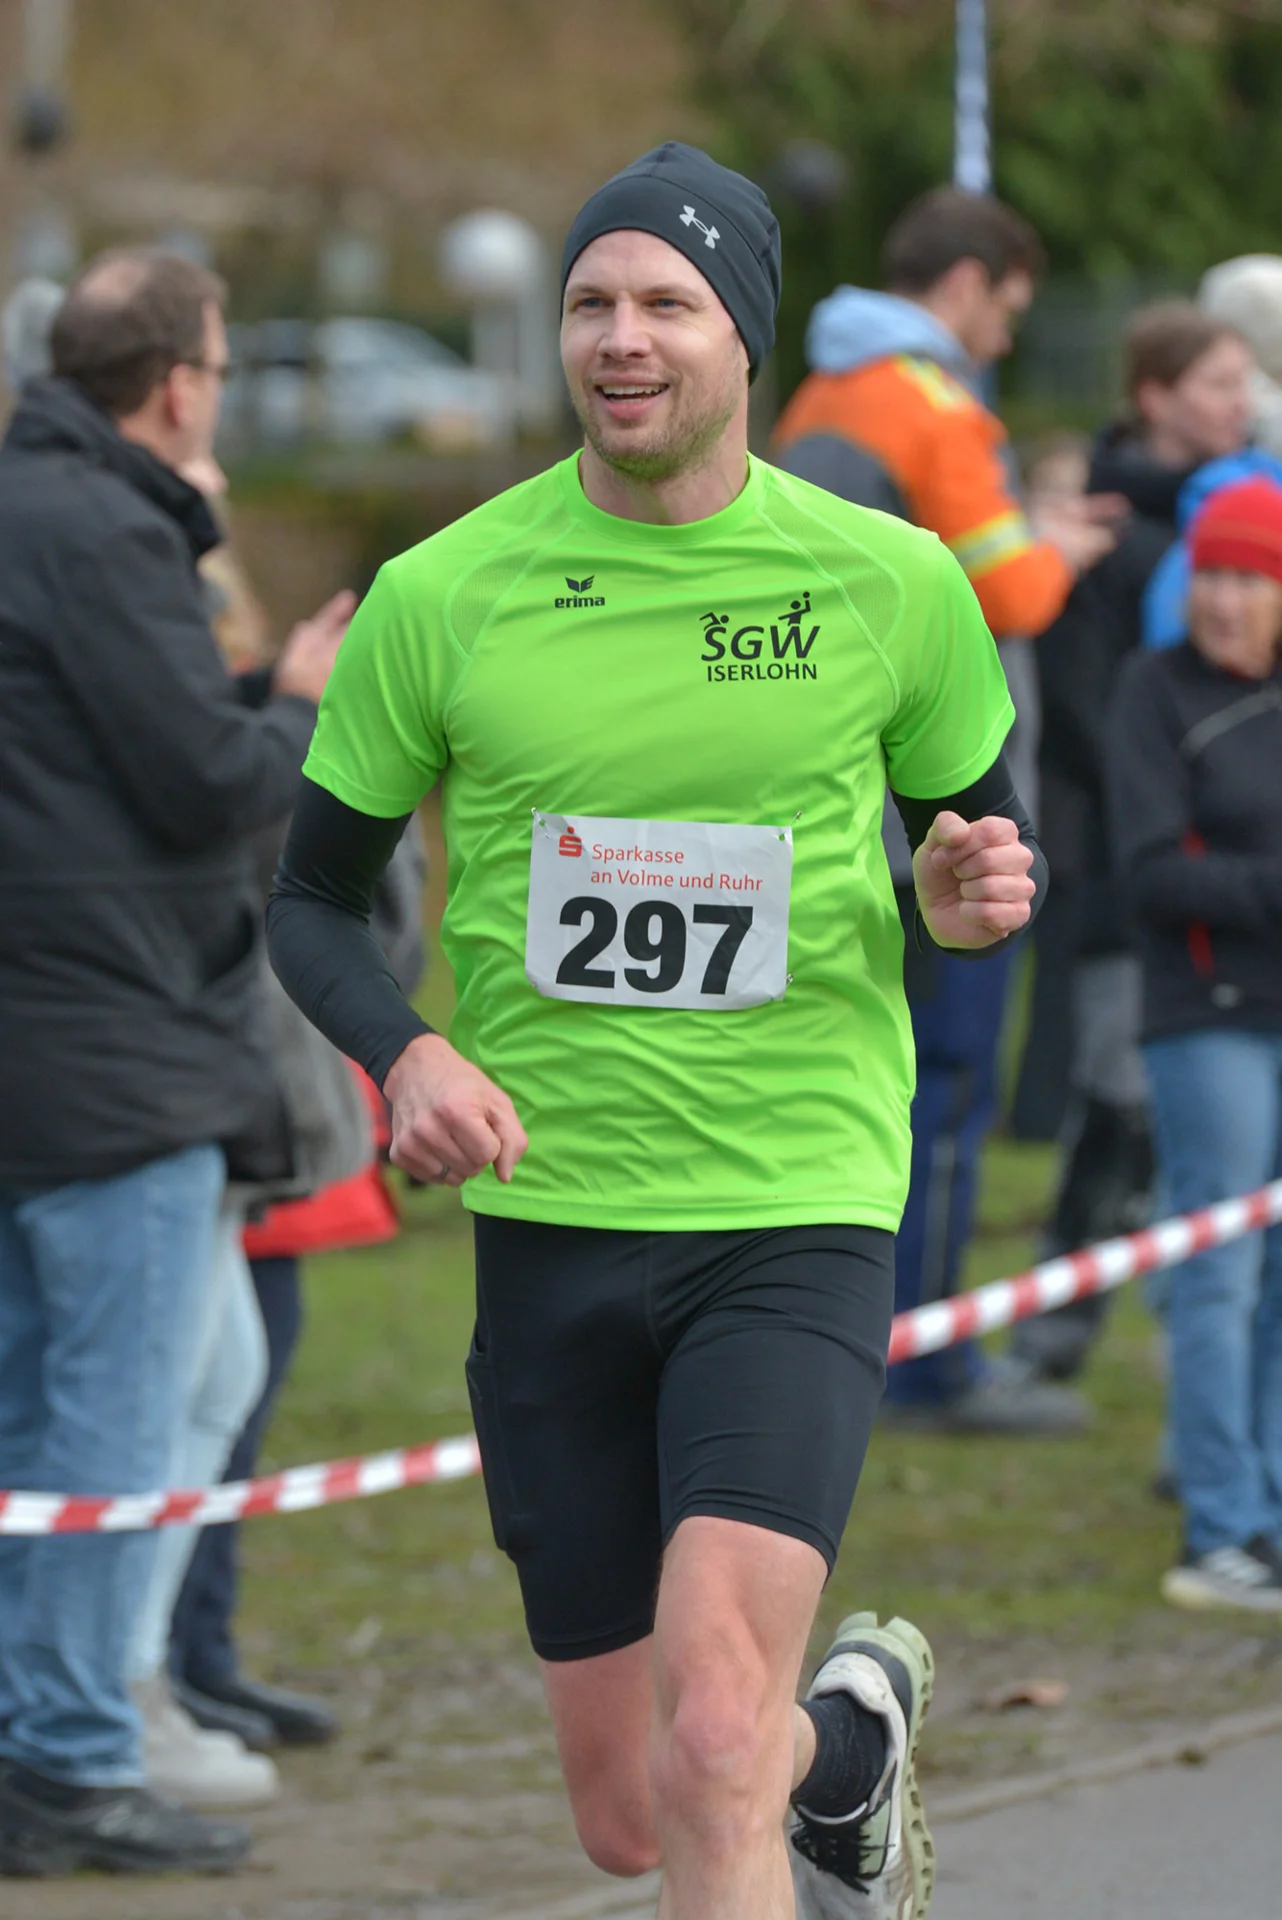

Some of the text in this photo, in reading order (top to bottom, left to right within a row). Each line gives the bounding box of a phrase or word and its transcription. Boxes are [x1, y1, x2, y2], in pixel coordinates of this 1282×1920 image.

[554, 594, 606, 609] erima
[701, 625, 821, 662] SGW
[707, 663, 818, 682] ISERLOHN
[591, 844, 685, 864] Sparkasse
[590, 869, 763, 891] an Volme und Ruhr
[555, 895, 754, 995] 297
